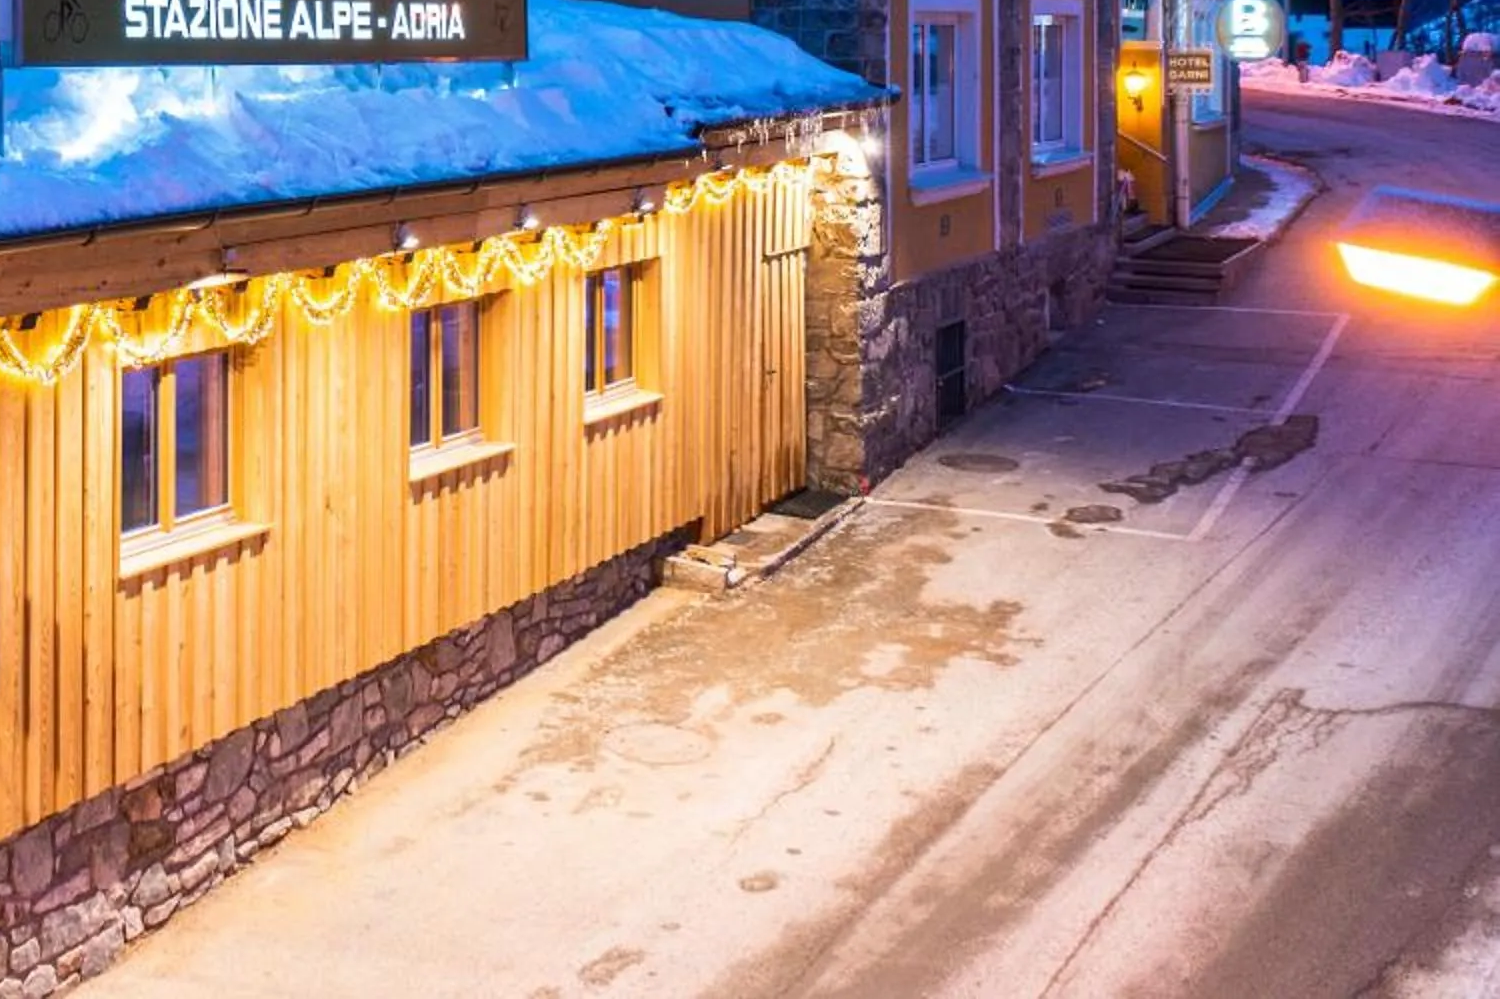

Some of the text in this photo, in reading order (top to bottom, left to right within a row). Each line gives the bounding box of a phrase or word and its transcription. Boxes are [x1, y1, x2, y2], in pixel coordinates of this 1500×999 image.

[289, 0, 374, 41] ALPE
[391, 2, 466, 41] ADRIA
[1169, 57, 1209, 68] HOTEL
